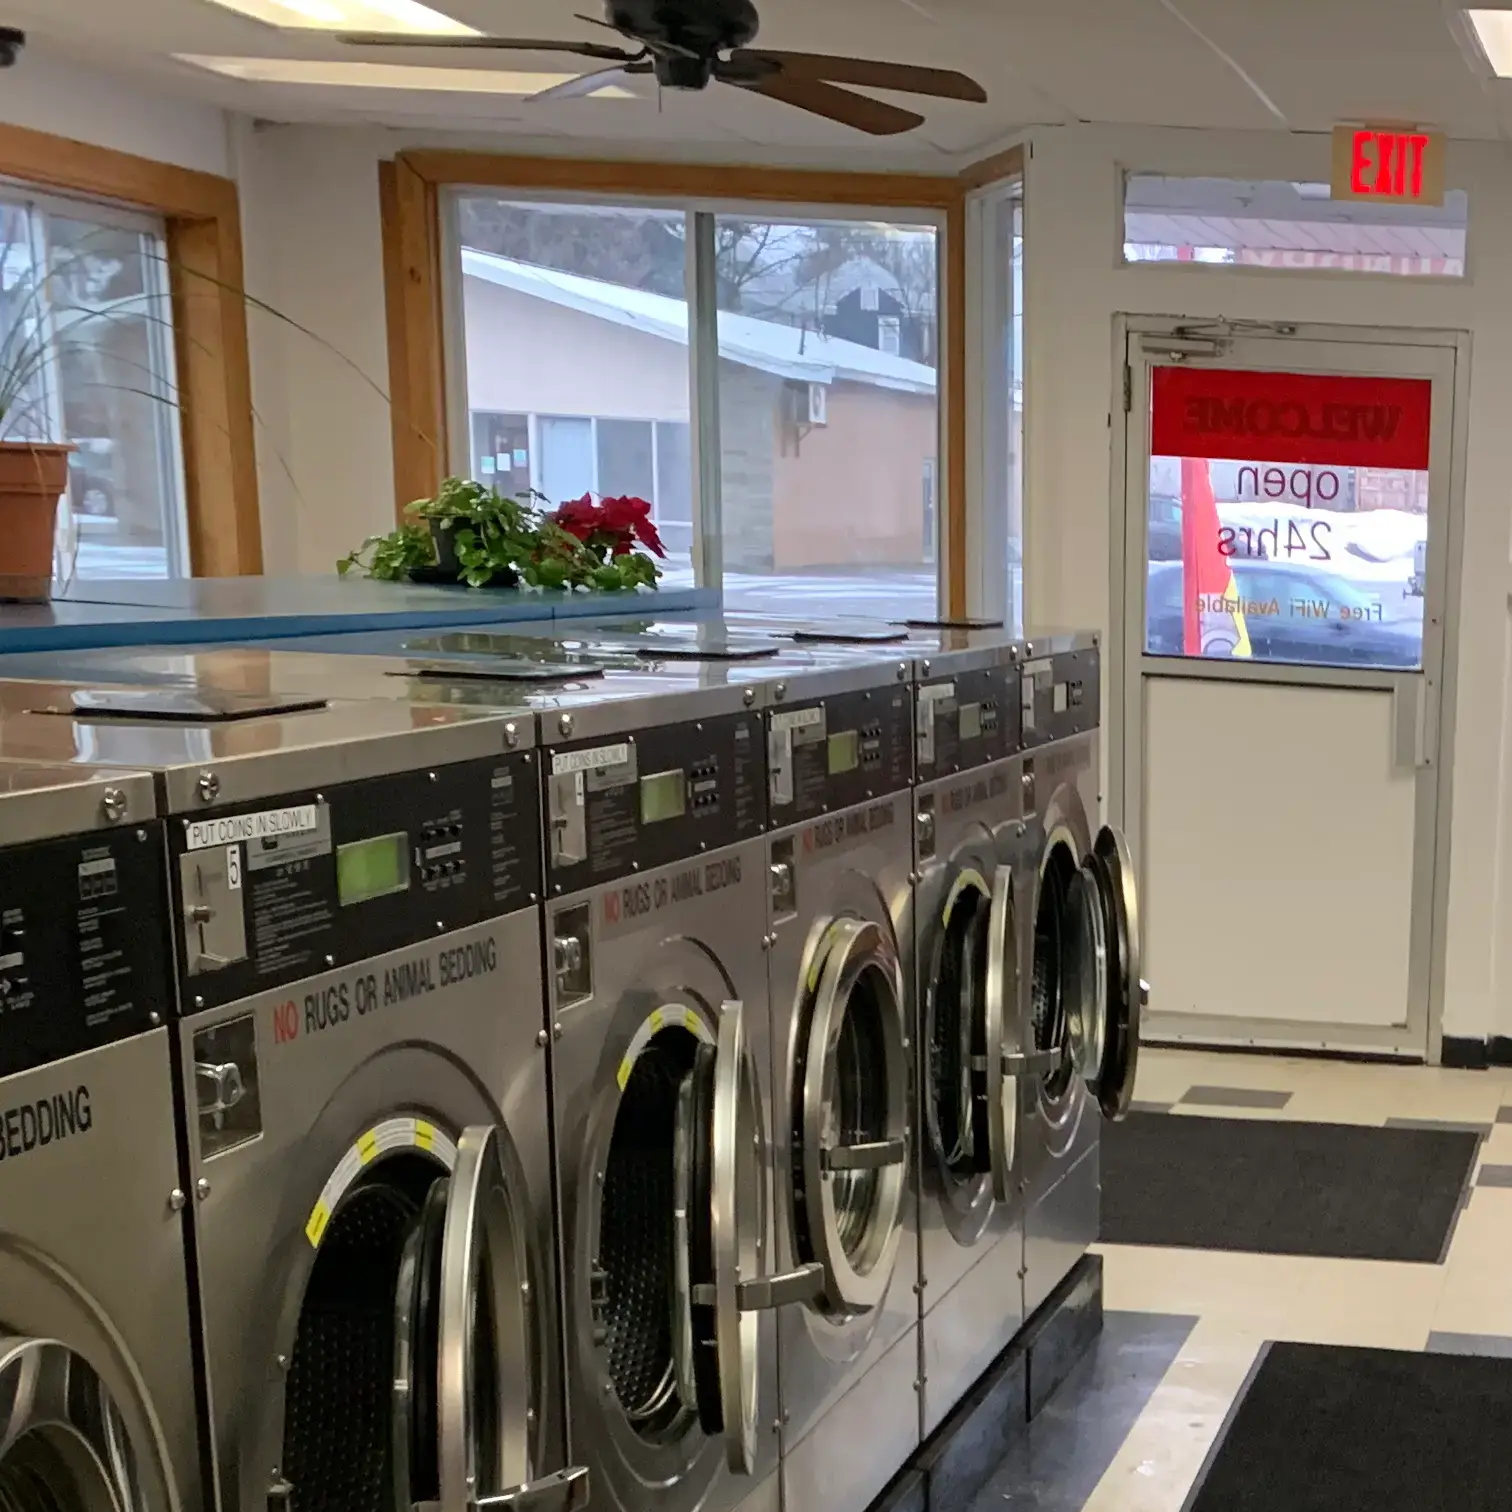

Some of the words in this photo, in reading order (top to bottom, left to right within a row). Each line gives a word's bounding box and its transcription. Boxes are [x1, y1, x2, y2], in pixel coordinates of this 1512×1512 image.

[1351, 130, 1430, 197] EXIT
[192, 821, 216, 845] PUT
[218, 817, 253, 841] COINS
[256, 814, 267, 834] IN
[268, 808, 313, 832] SLOWLY
[229, 849, 240, 885] 5
[273, 1000, 299, 1044] NO
[304, 982, 350, 1034] RUGS
[355, 974, 378, 1016] OR
[384, 958, 435, 1007] ANIMAL
[439, 936, 498, 987] BEDDING
